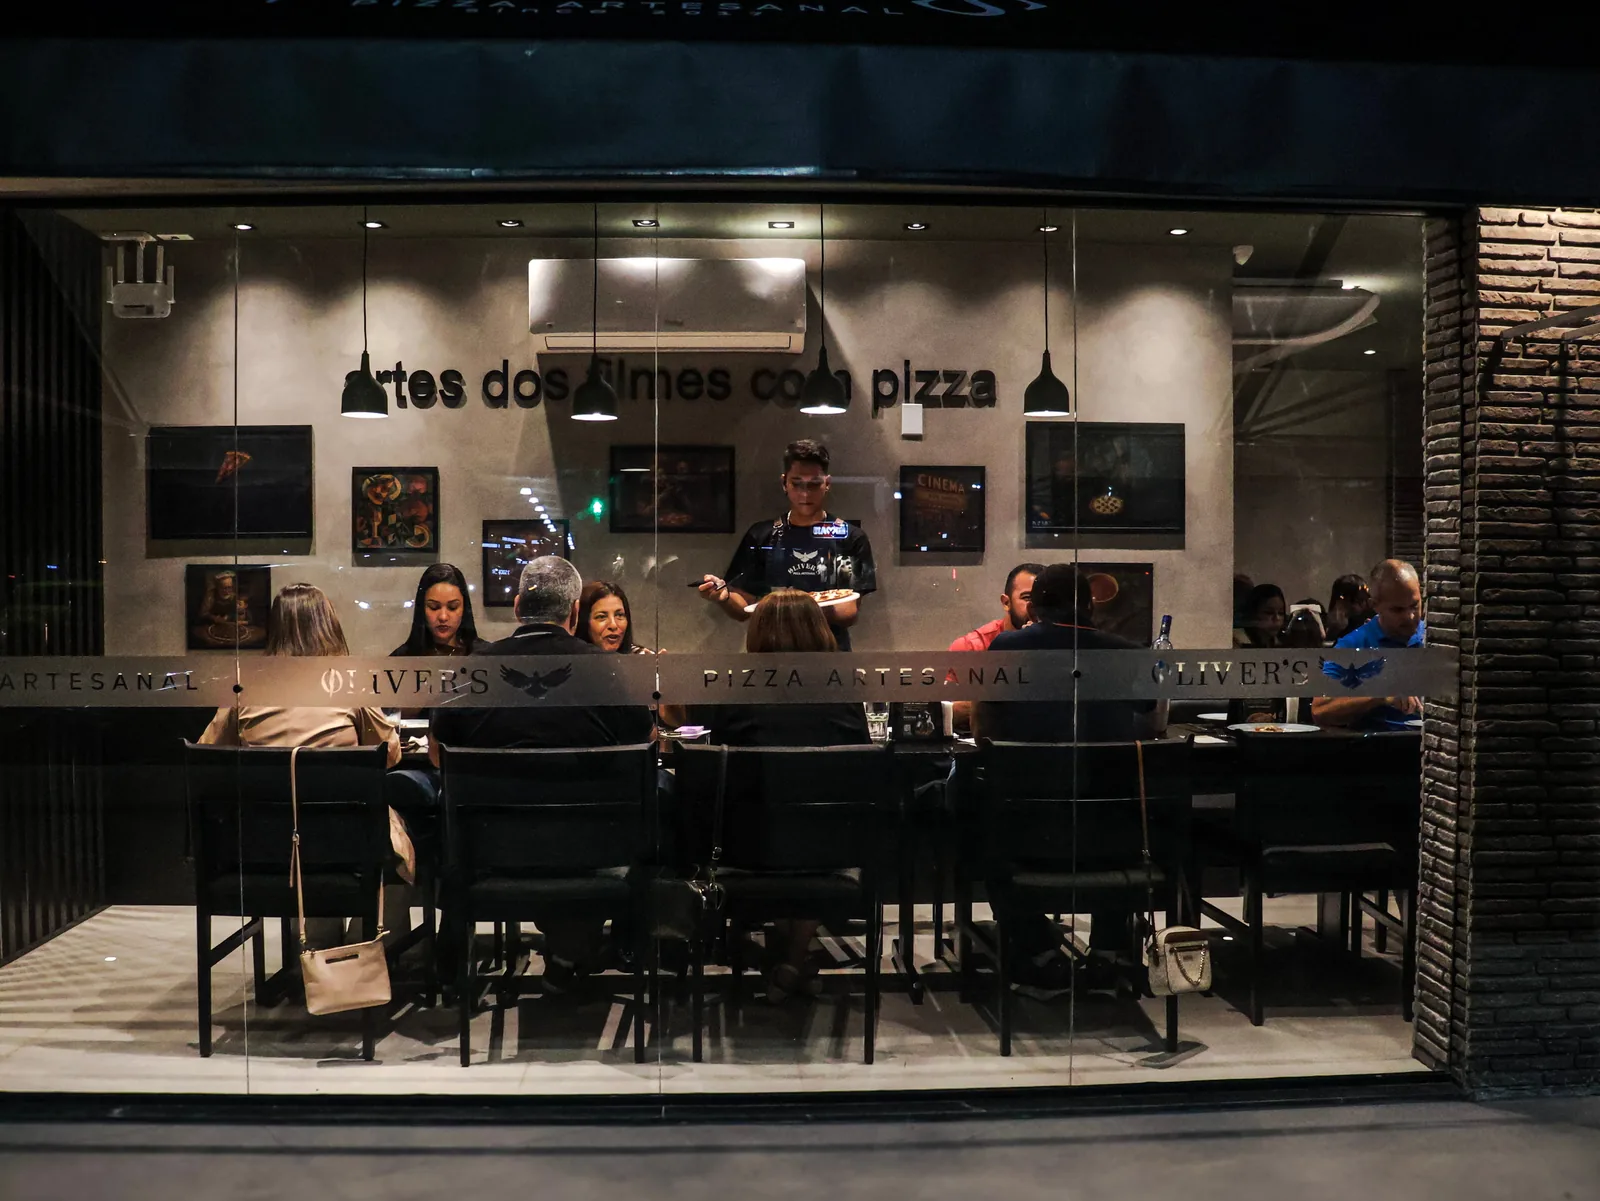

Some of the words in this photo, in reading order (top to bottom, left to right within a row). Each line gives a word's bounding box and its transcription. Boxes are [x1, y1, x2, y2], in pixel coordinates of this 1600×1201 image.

[556, 1, 905, 15] ARTESANAL
[482, 359, 569, 408] dos
[587, 358, 731, 401] ilmes
[918, 474, 965, 493] CINEMA
[787, 562, 821, 576] OLIVERS
[1, 671, 197, 691] ARTESANAL
[704, 668, 803, 688] PIZZA
[827, 667, 1030, 687] ARTESANAL
